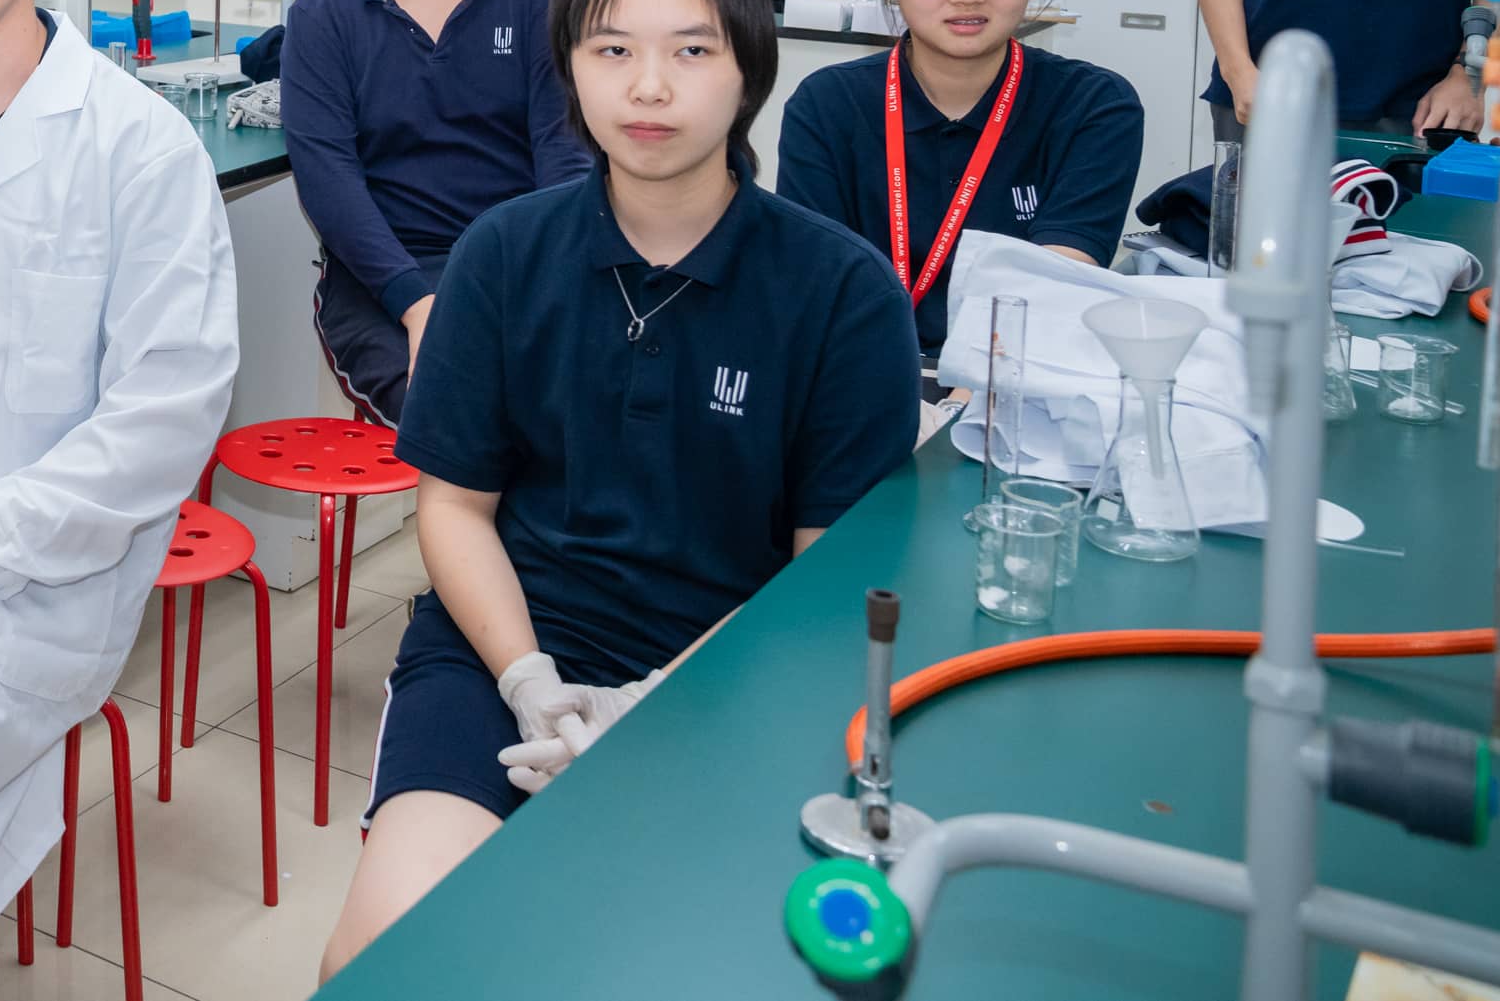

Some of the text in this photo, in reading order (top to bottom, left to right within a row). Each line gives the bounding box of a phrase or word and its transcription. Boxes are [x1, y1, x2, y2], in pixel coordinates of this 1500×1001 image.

[888, 83, 898, 112] ULINK
[893, 167, 906, 290] LINK www.sz-alevel.com
[918, 176, 977, 291] ULINK www.sz-alevel.com
[710, 401, 744, 416] ULINK
